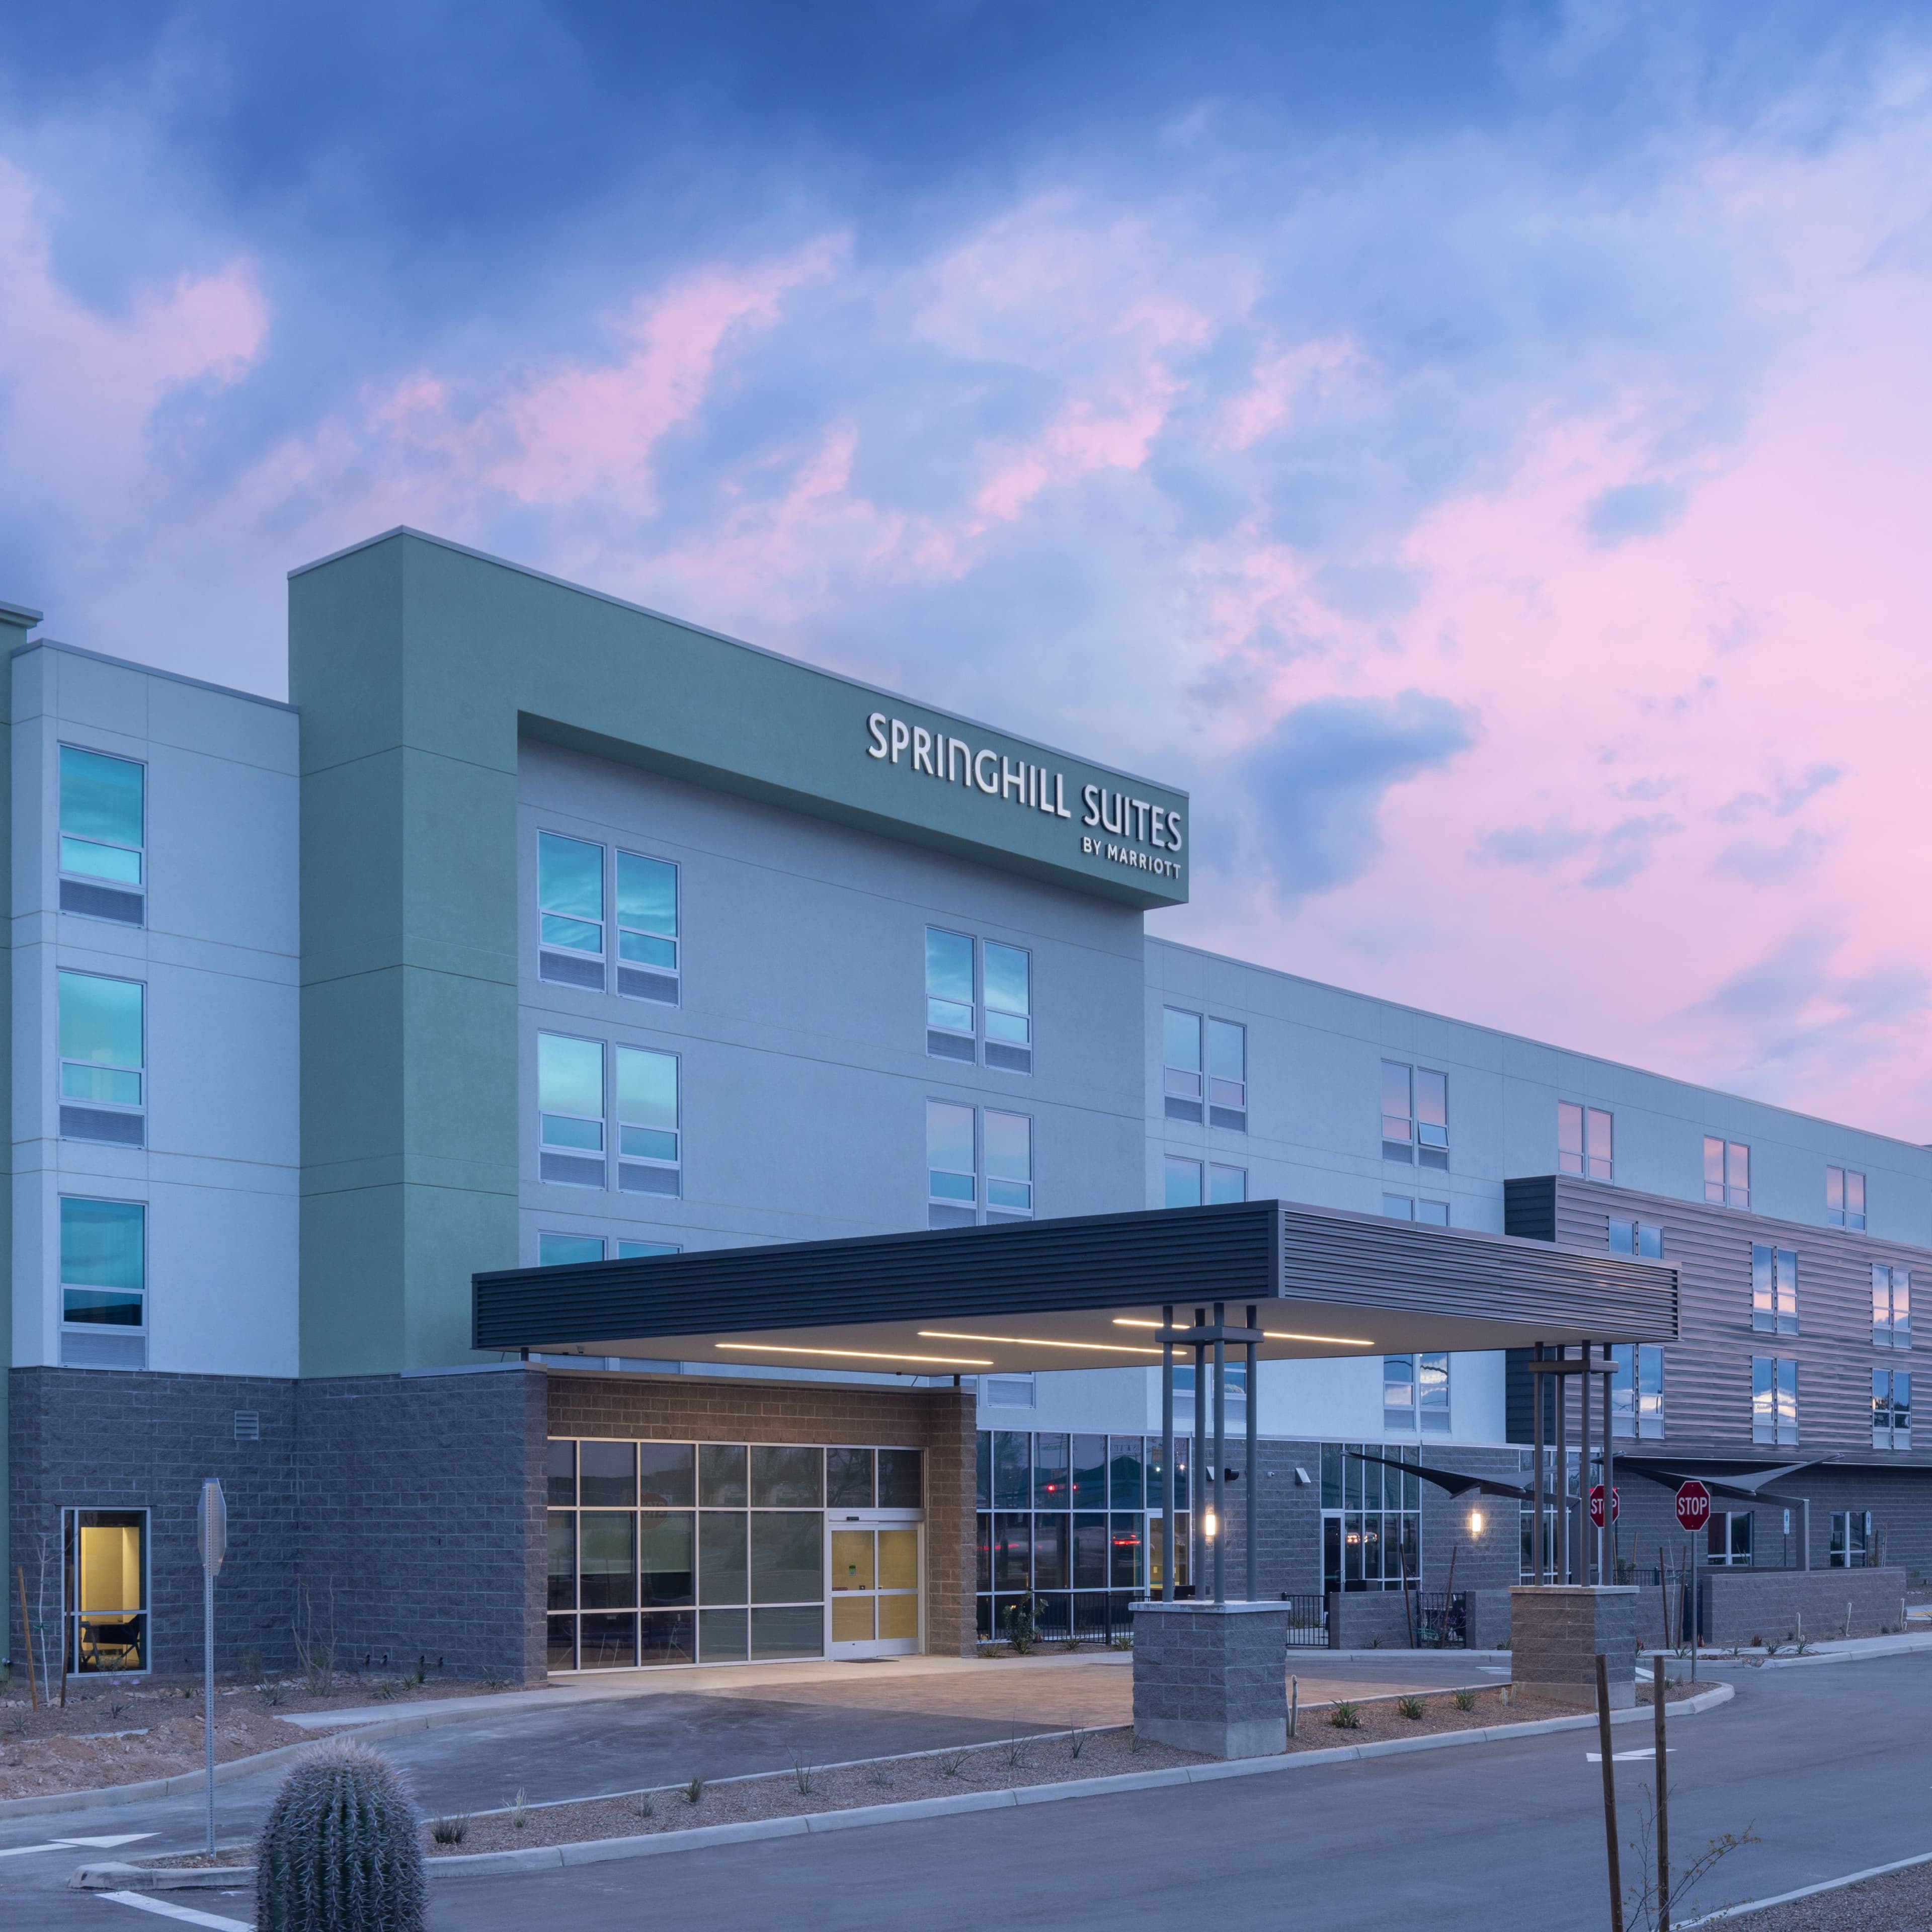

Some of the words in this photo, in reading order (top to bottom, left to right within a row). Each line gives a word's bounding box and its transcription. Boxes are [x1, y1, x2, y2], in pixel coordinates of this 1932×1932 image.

[866, 712, 1071, 818] SPRINGHILL
[1082, 784, 1182, 852] SUITES
[1082, 836, 1101, 855] BY
[1106, 843, 1181, 879] MARRIOTT
[1591, 1498, 1617, 1514] STP
[1678, 1497, 1707, 1515] STOP
